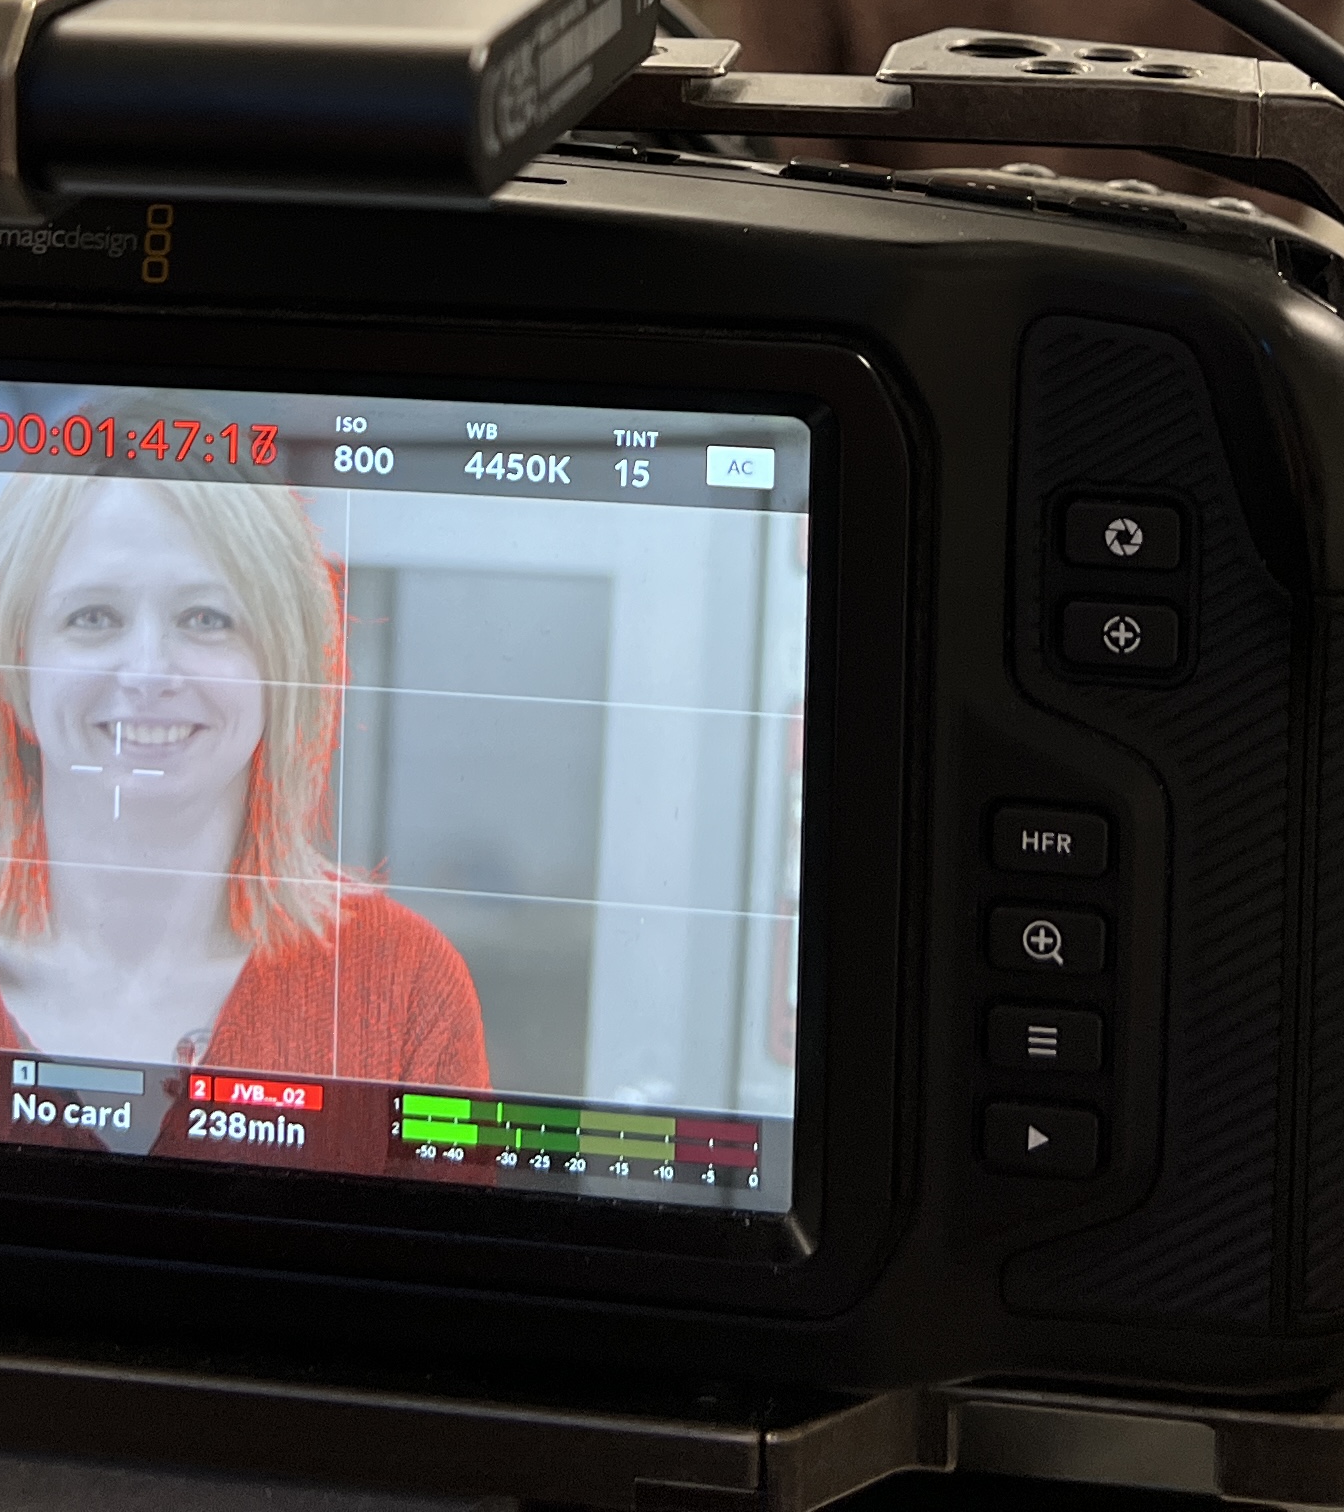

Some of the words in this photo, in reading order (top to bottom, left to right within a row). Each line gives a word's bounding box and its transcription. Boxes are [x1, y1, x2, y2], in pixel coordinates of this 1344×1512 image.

[334, 415, 368, 434] ISO
[465, 421, 498, 440] WB
[612, 429, 659, 449] TINT
[332, 444, 395, 476] 800
[463, 450, 571, 485] 4450K
[726, 456, 755, 477] AC
[613, 457, 651, 488] 15
[1022, 829, 1072, 855] HFR
[20, 1065, 29, 1080] 1
[194, 1079, 206, 1097] 2
[12, 1092, 56, 1123] No
[63, 1098, 132, 1131] card
[187, 1108, 306, 1147] 238min
[391, 1121, 401, 1136] 2
[415, 1145, 437, 1160] -50
[441, 1147, 464, 1162] -40
[495, 1152, 518, 1167] -30
[529, 1155, 551, 1170] -25
[564, 1157, 587, 1172] -20
[609, 1162, 629, 1176] -15
[653, 1165, 674, 1180] -10
[701, 1169, 716, 1184] -5
